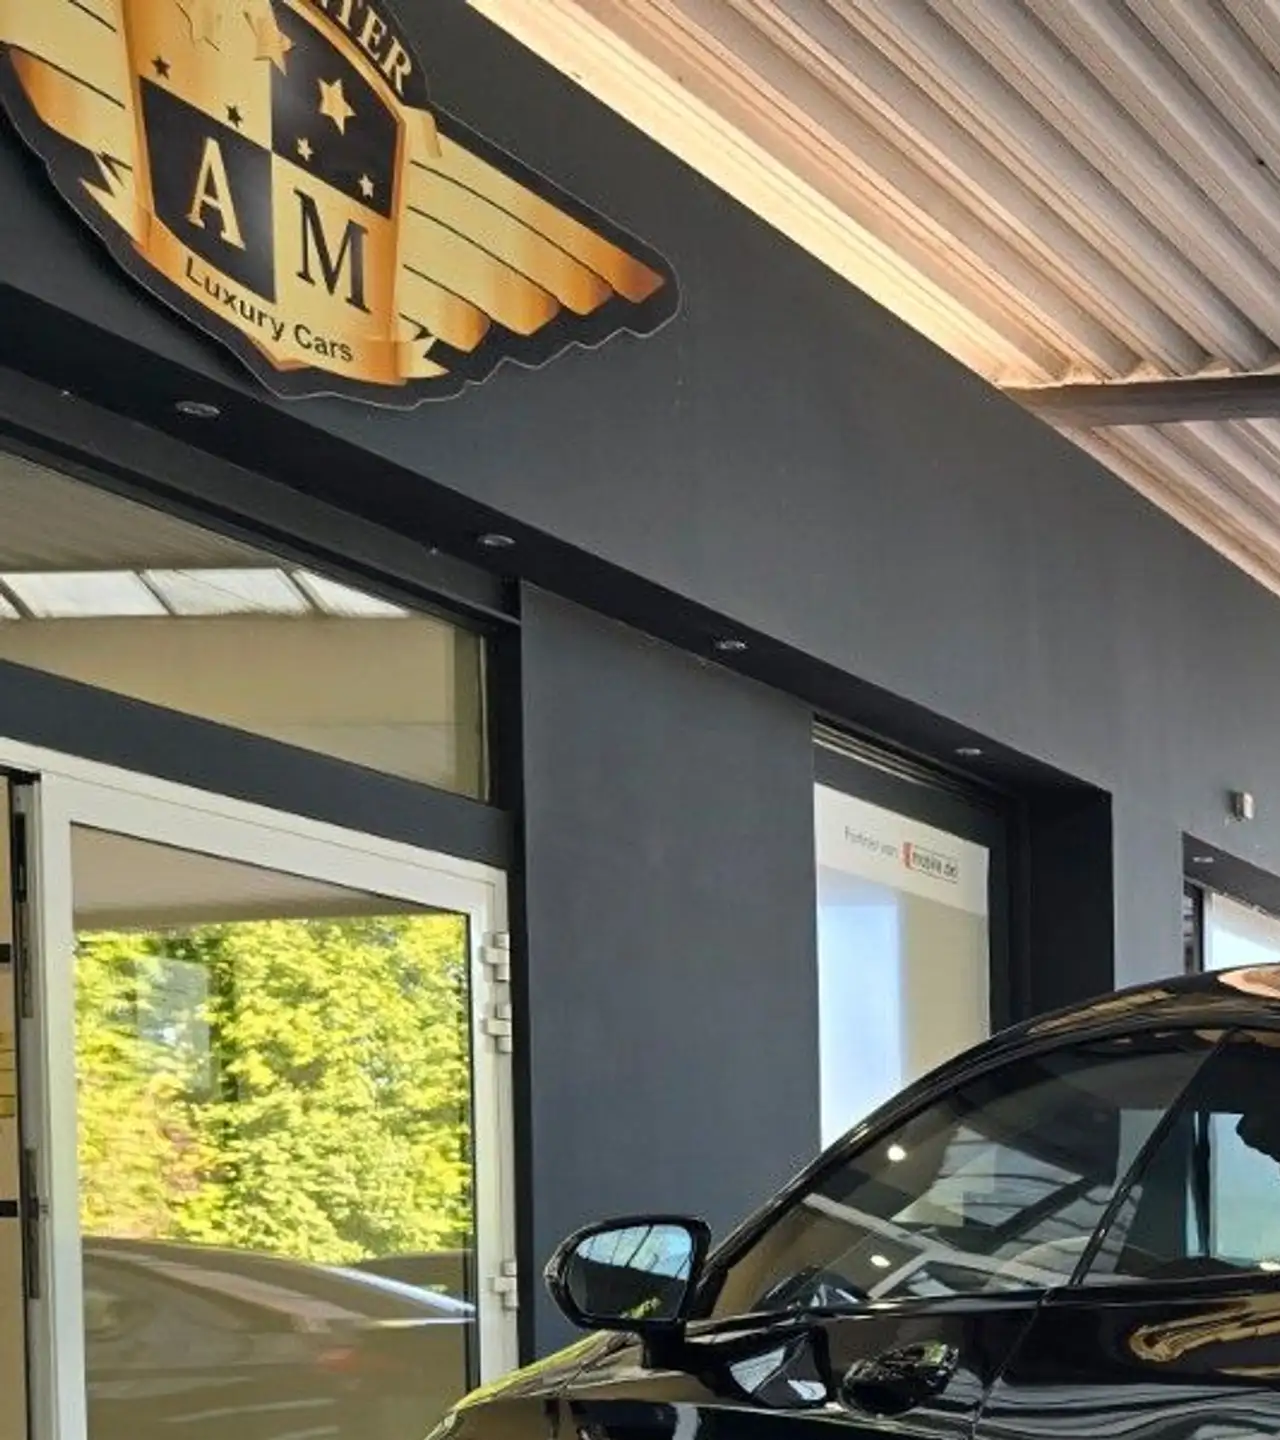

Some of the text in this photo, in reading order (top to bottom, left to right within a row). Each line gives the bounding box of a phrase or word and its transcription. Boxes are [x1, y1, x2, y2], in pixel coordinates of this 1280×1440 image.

[321, 0, 411, 97] TER
[185, 137, 372, 314] A M
[186, 257, 354, 363] Luxury Cars
